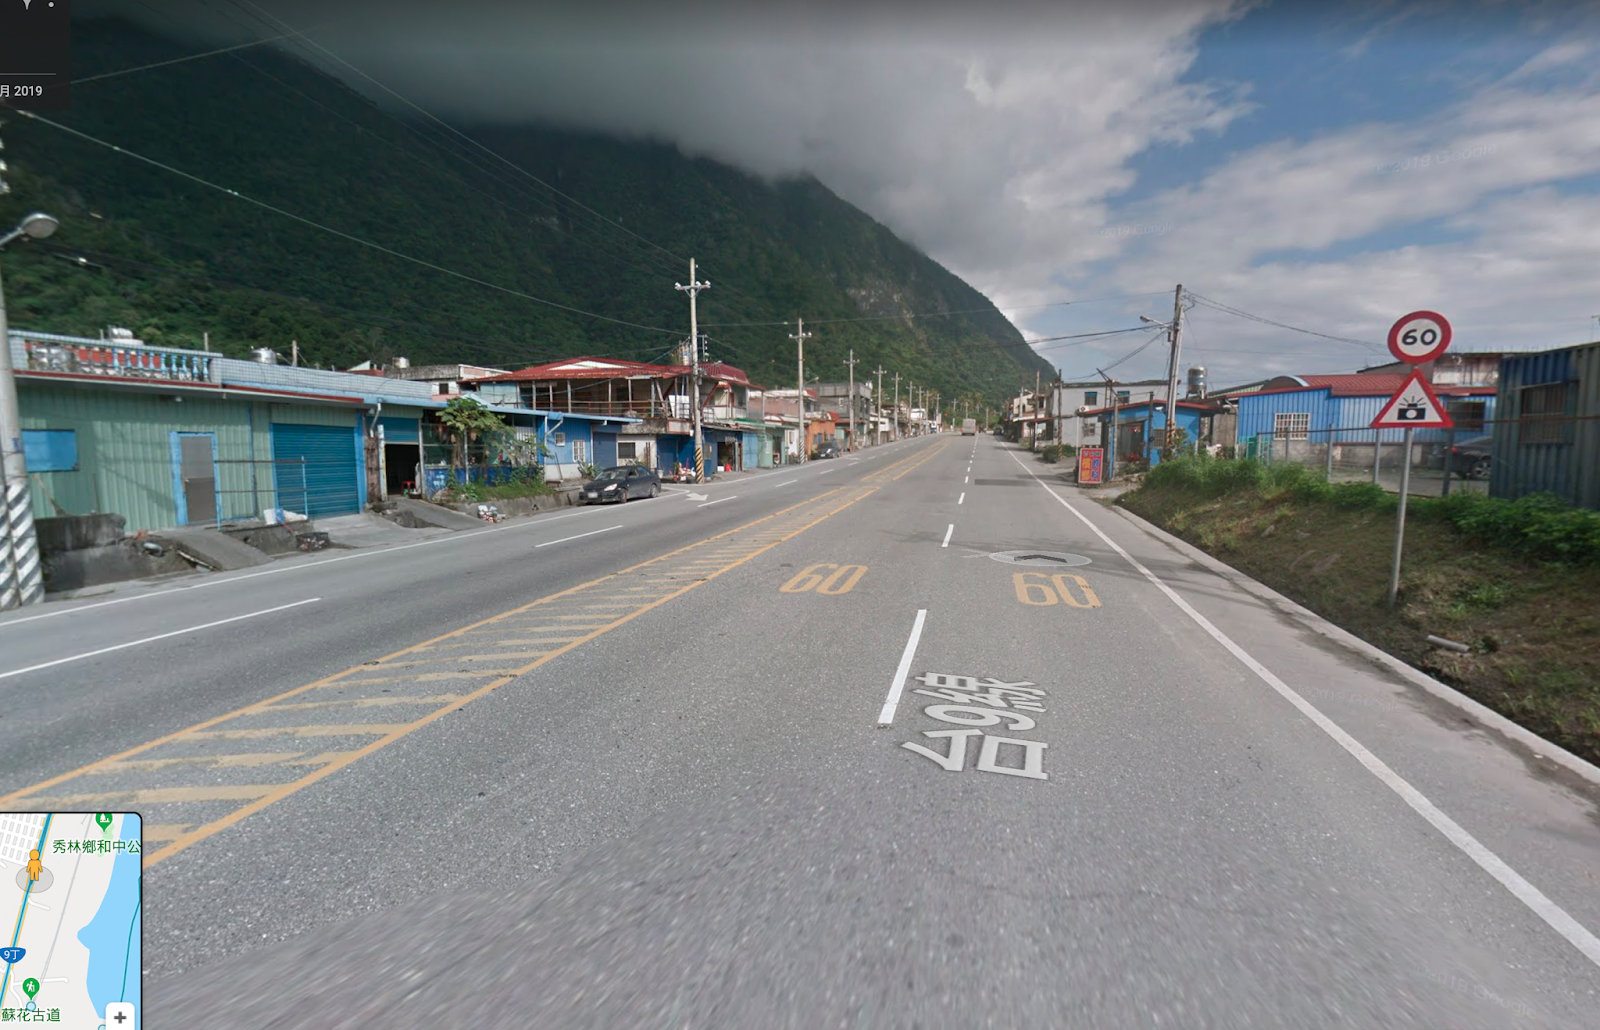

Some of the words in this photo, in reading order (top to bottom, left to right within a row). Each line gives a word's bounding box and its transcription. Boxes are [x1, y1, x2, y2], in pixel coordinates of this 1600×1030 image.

[1401, 329, 1437, 346] 60
[779, 563, 868, 595] 60
[1012, 572, 1102, 608] 60
